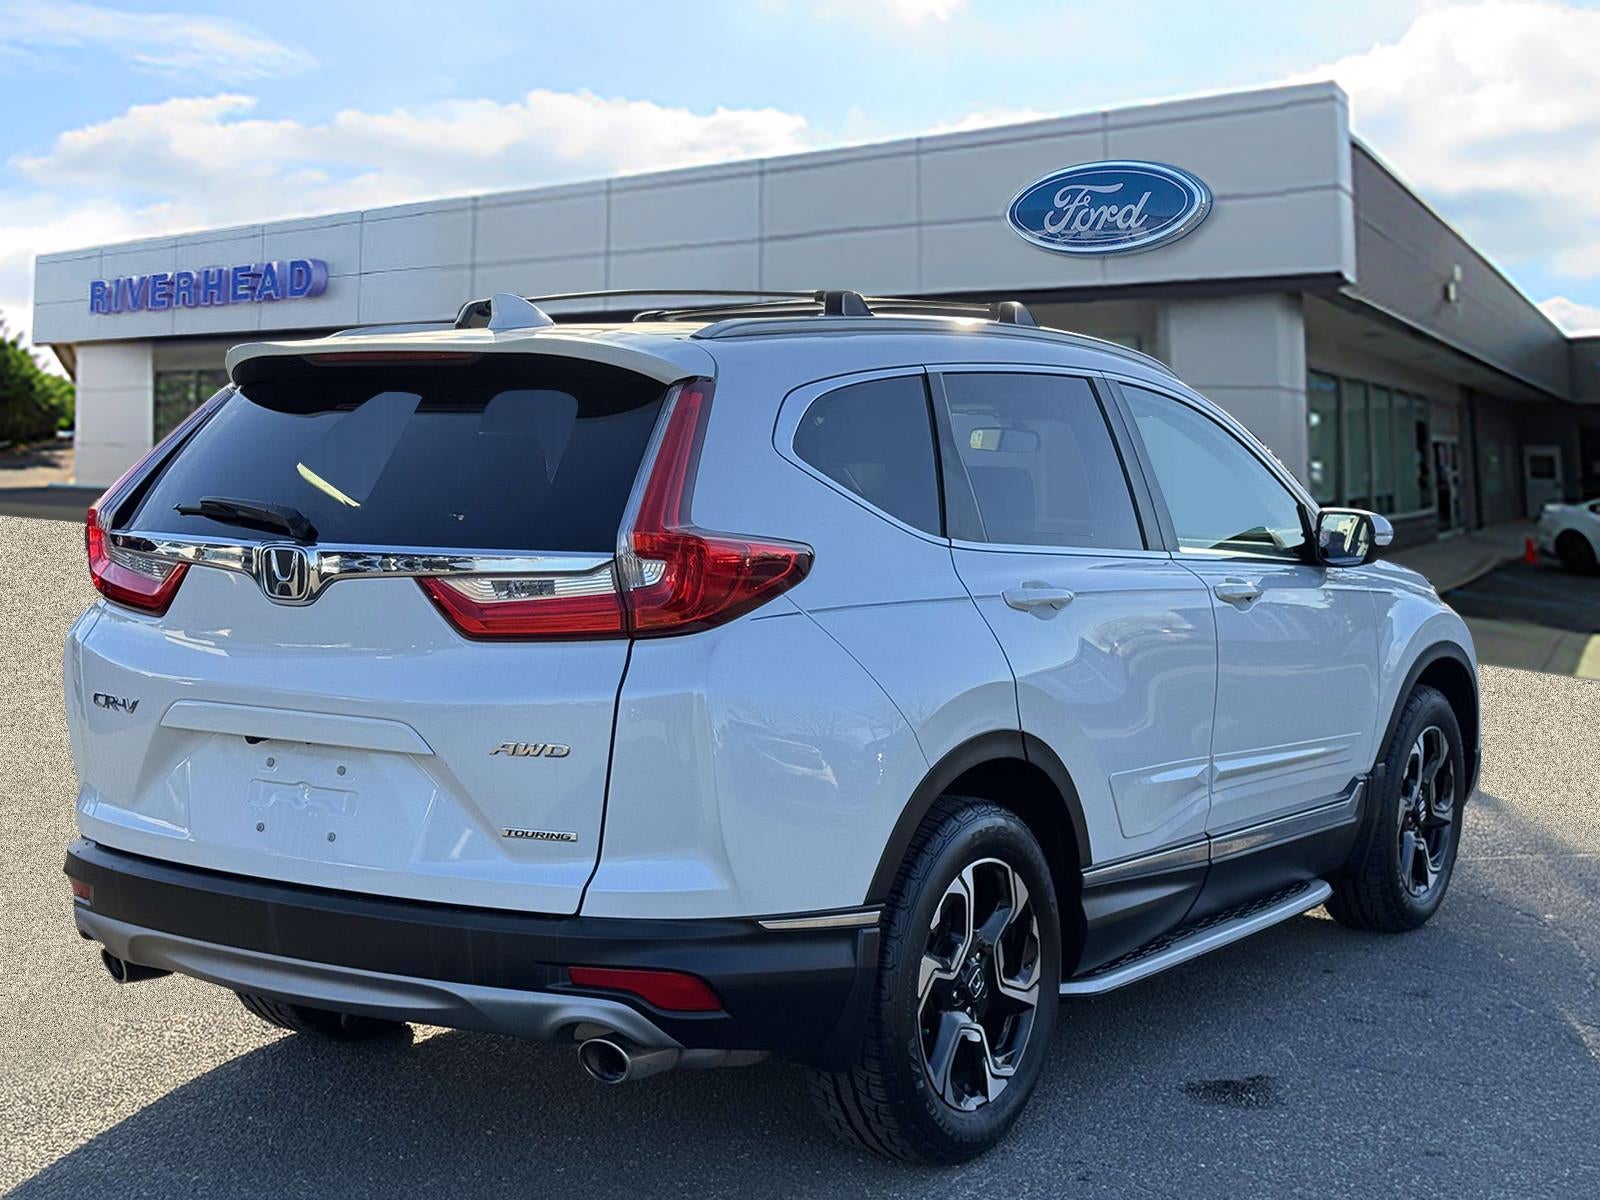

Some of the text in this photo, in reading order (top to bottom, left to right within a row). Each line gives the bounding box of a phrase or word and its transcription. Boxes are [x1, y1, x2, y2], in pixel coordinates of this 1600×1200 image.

[1043, 182, 1152, 234] Ford
[89, 259, 327, 315] RIVERHEAD
[93, 692, 140, 714] CR-V
[489, 741, 570, 758] AWD
[505, 828, 572, 840] TOURING
